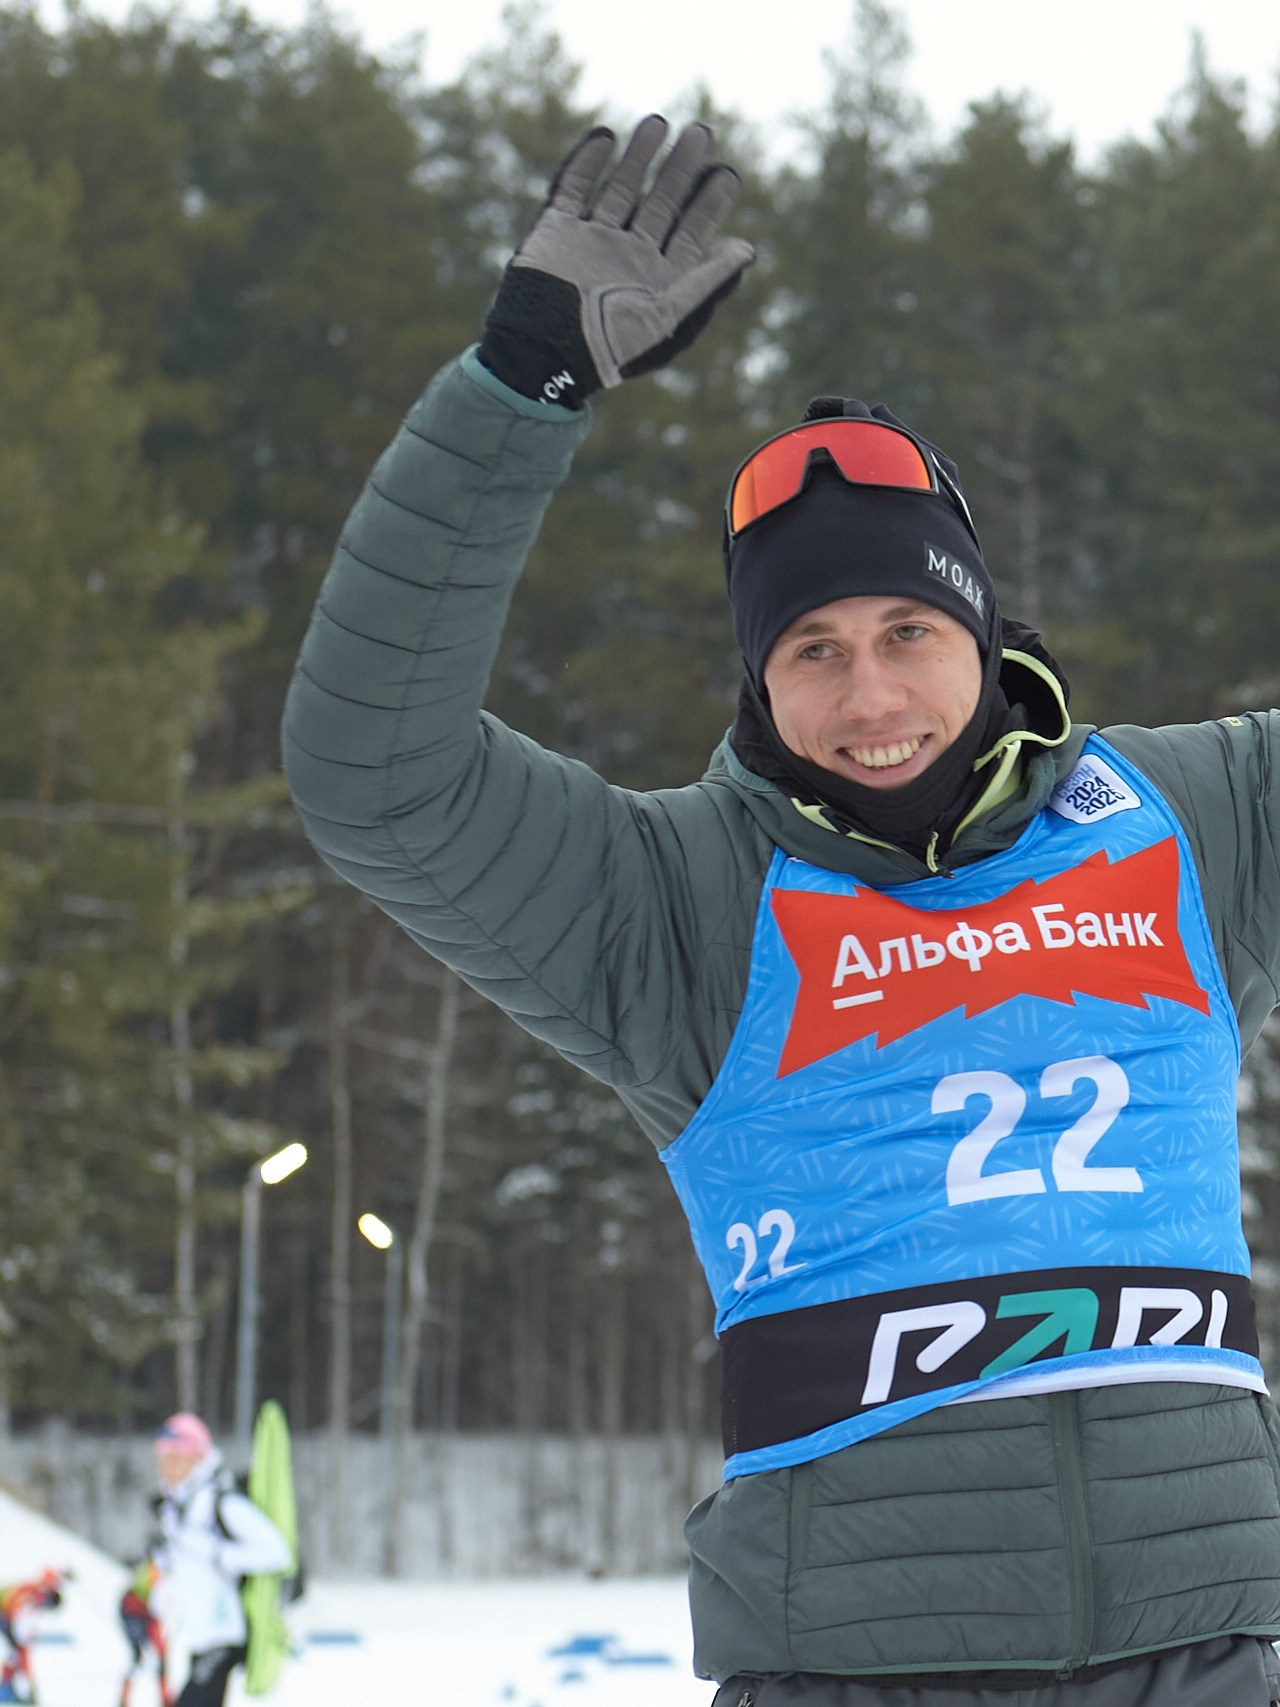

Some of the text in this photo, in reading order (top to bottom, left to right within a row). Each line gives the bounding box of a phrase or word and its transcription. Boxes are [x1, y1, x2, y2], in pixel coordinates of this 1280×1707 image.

[538, 369, 576, 405] MO
[927, 548, 984, 611] MOAX
[1066, 775, 1110, 809] 2024
[1080, 788, 1126, 816] 2025
[832, 903, 1165, 988] Альфа Банк
[931, 1055, 1144, 1206] 22
[726, 1209, 808, 1291] 22
[861, 1287, 1228, 1406] PARI
